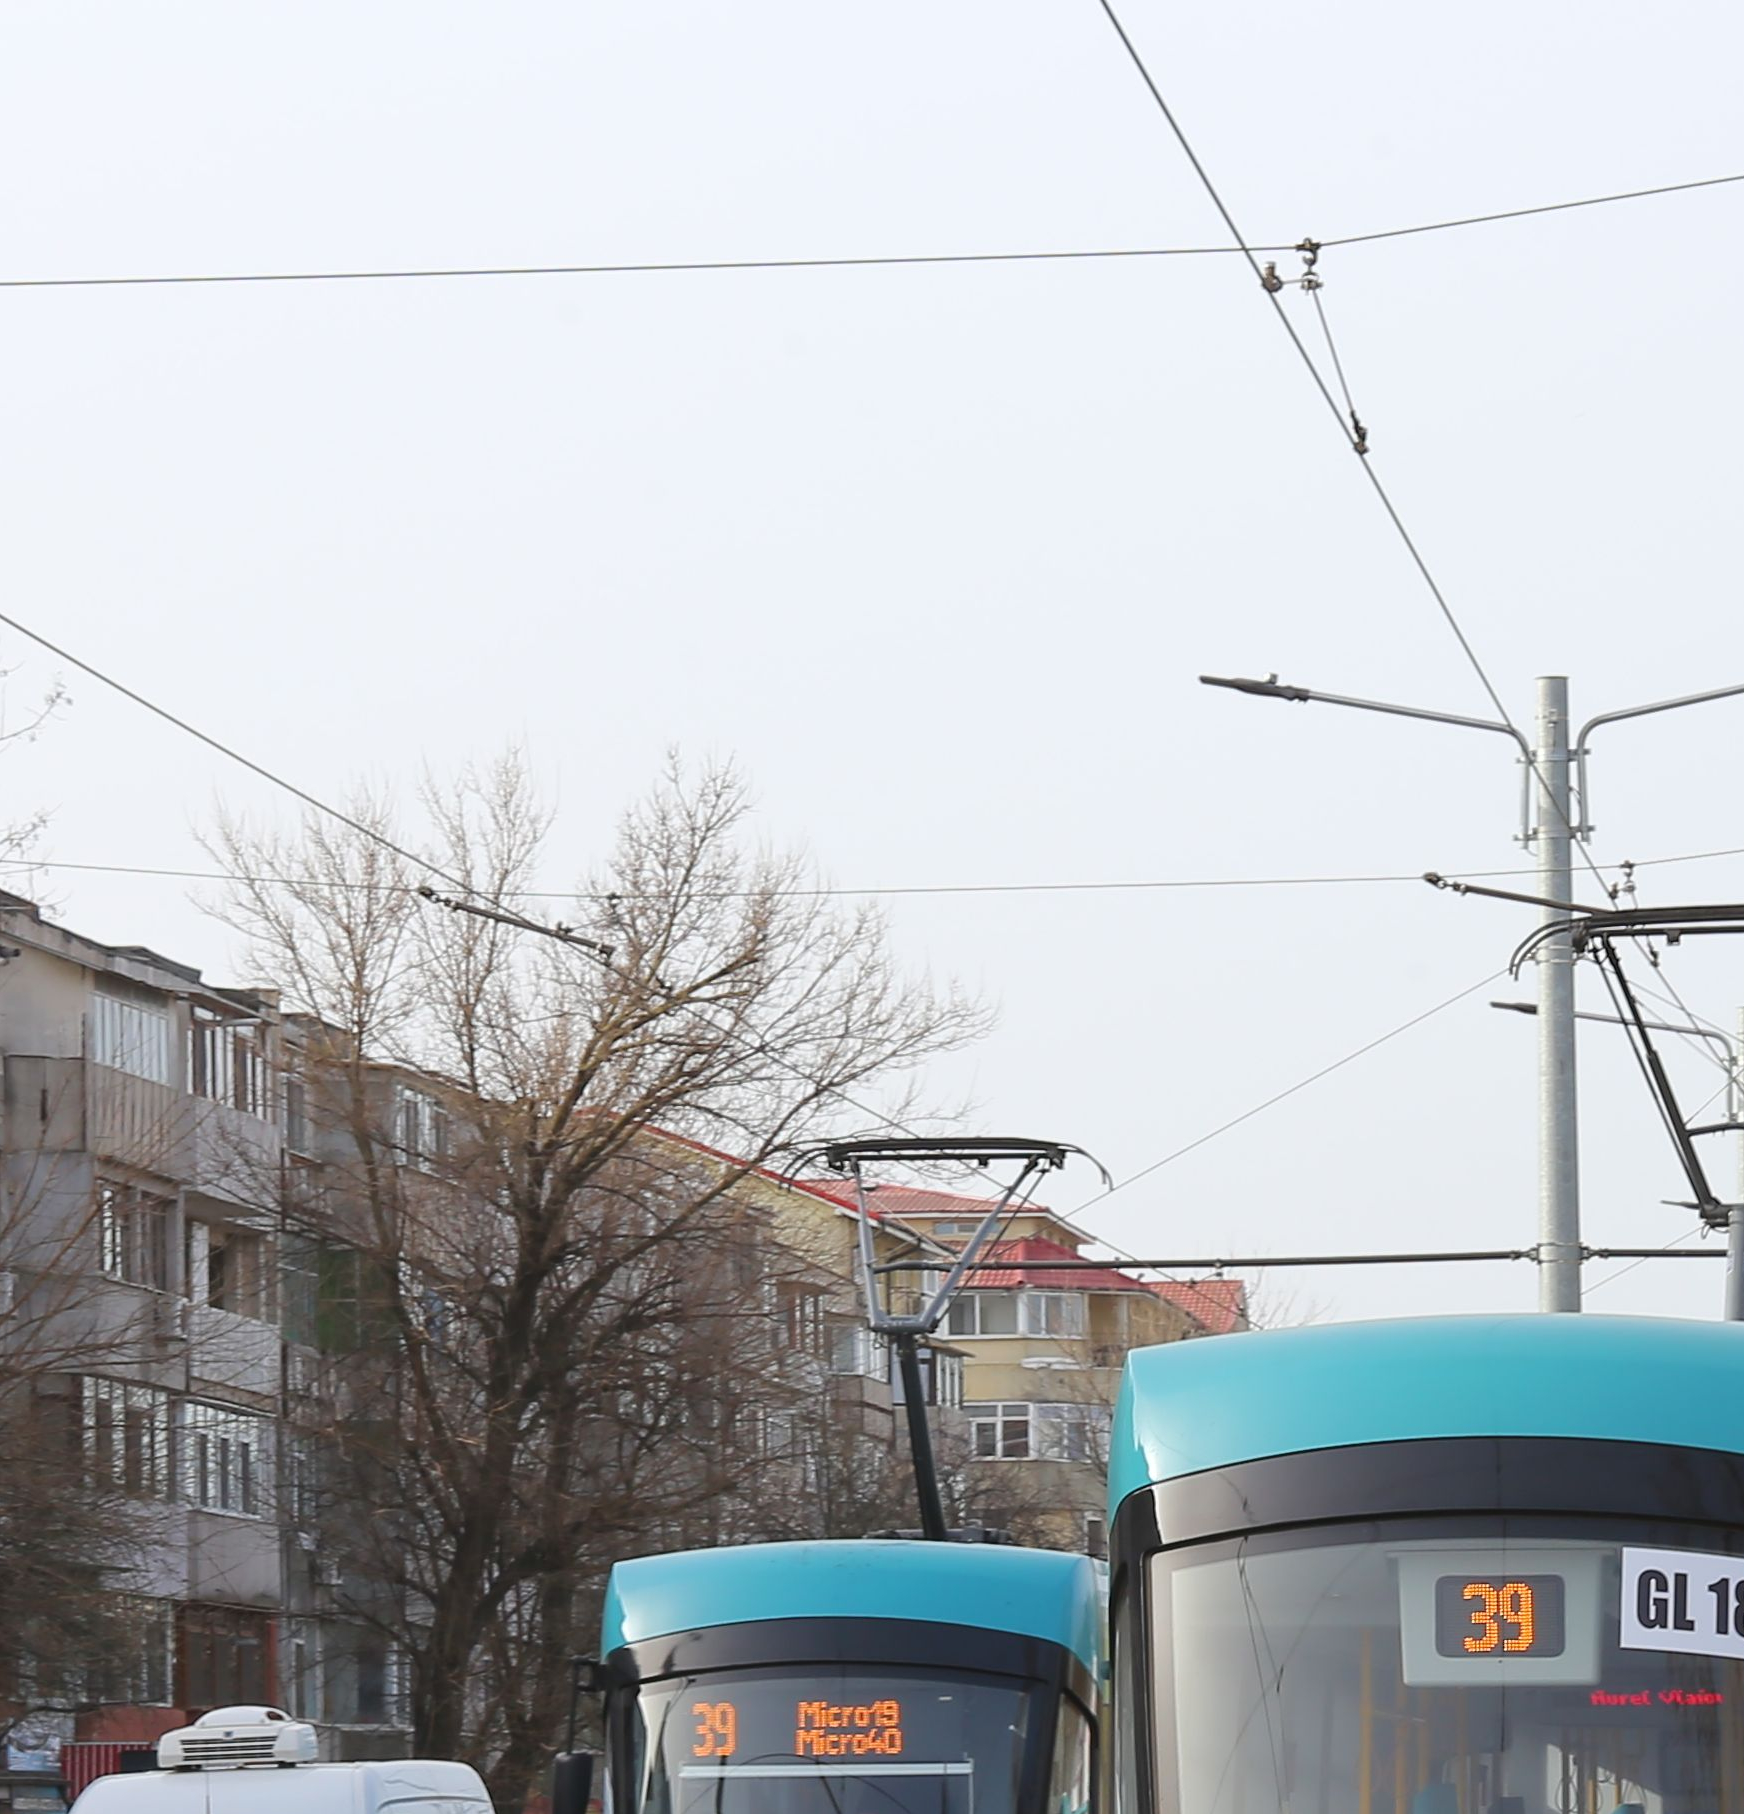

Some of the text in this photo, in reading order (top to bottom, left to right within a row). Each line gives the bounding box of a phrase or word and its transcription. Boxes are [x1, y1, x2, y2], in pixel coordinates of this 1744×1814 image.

[1462, 1582, 1534, 1653] 39
[1636, 1569, 1695, 1631] GL
[691, 1702, 736, 1757] 39
[797, 1700, 900, 1728] Micro19
[795, 1728, 902, 1756] Micro40
